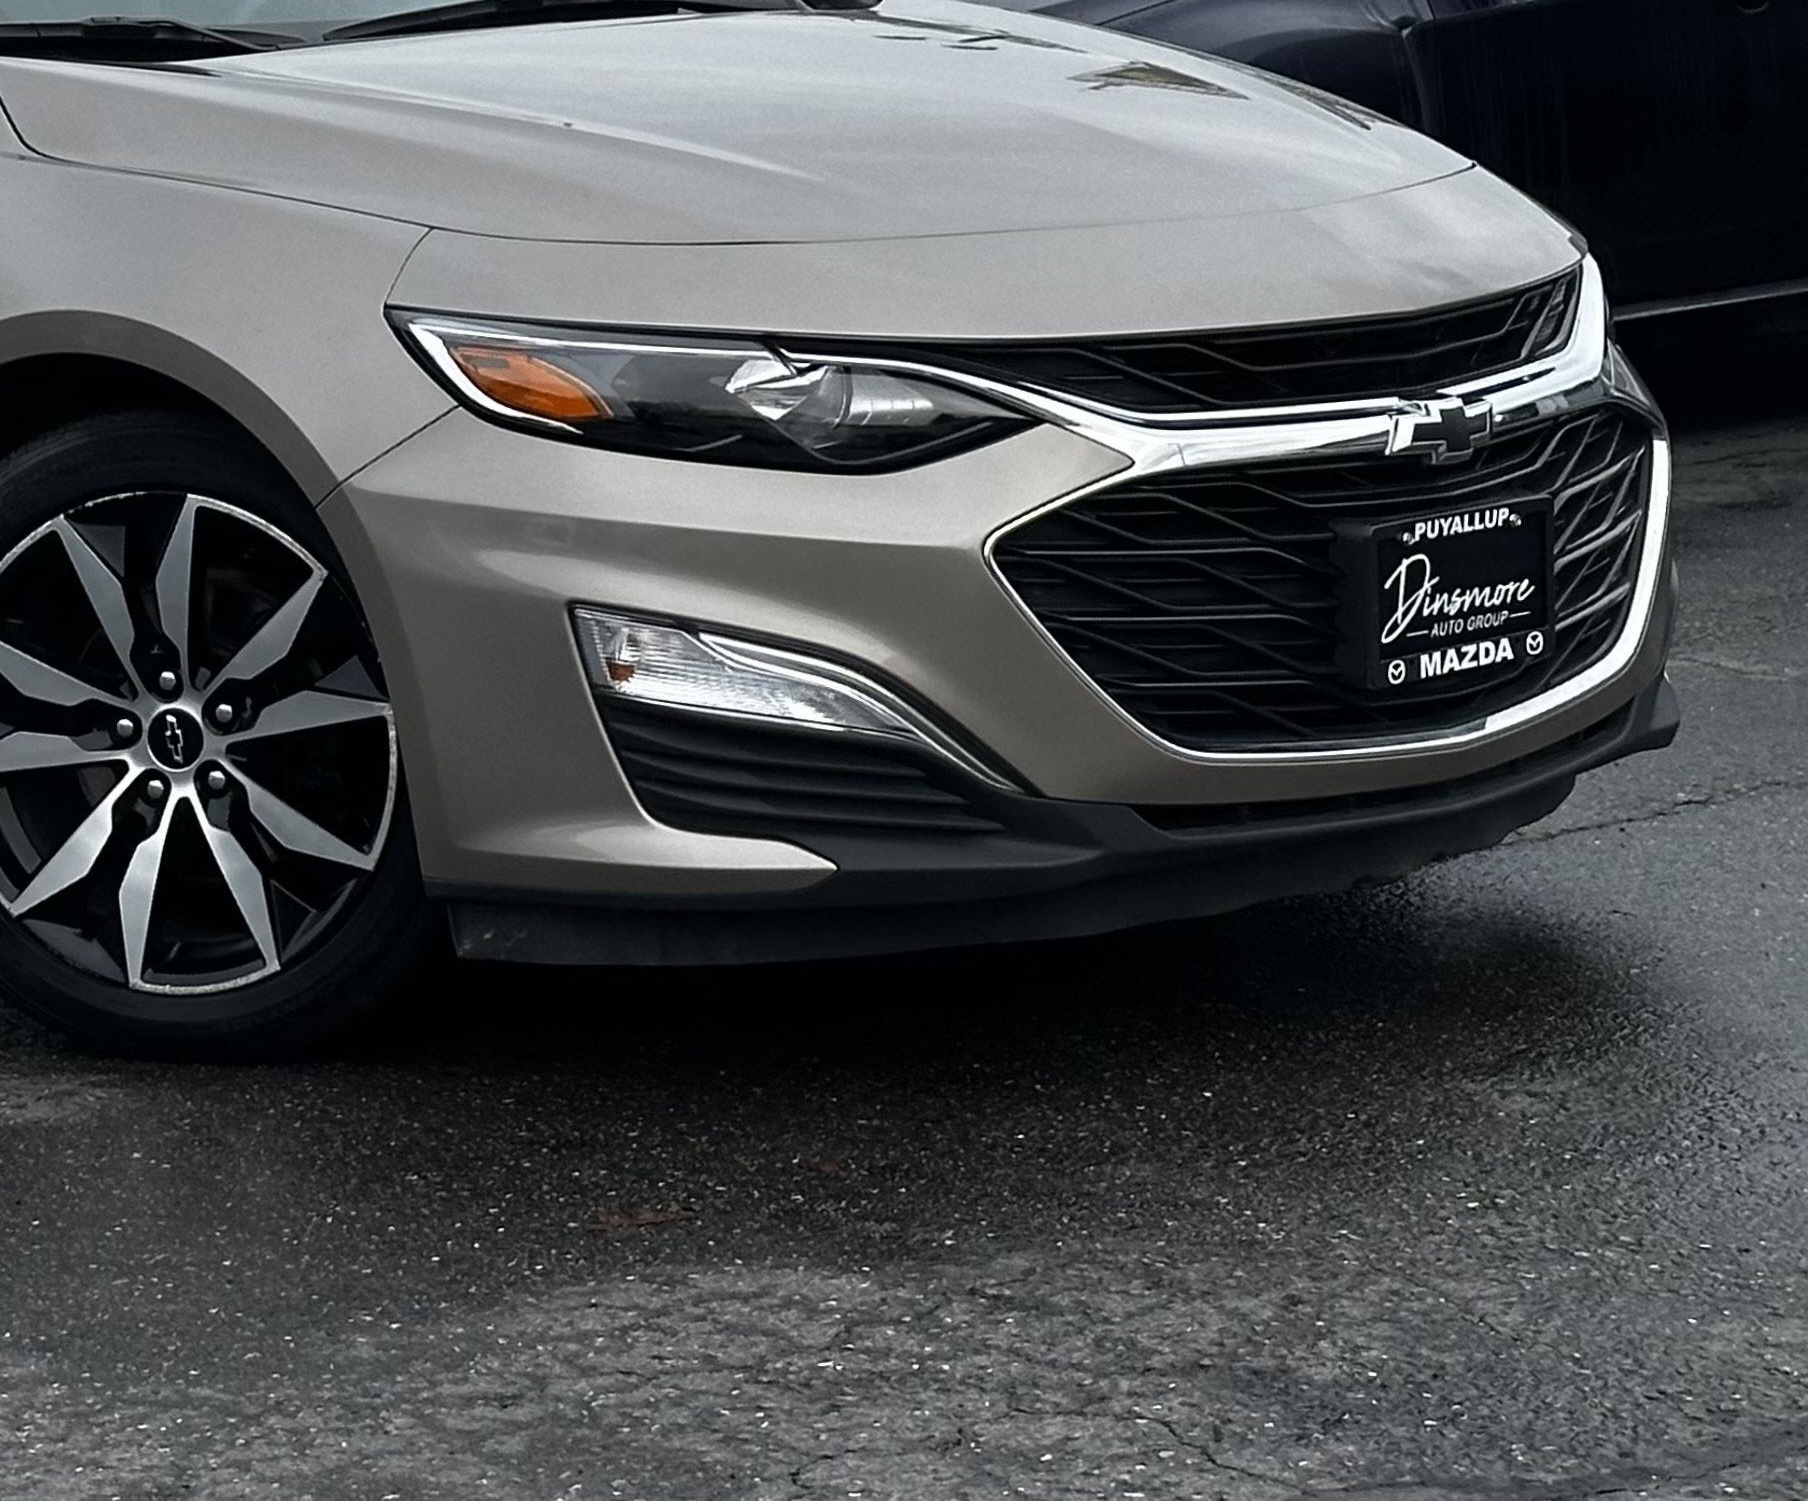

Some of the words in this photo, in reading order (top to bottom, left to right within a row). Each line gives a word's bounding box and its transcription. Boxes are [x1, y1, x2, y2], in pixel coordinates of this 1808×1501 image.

[1414, 507, 1510, 541] PUYALLUP
[1381, 553, 1535, 643] Dinsmore
[1430, 619, 1463, 637] AUTO
[1467, 610, 1508, 631] GROUP
[1419, 637, 1514, 679] MAZDA
